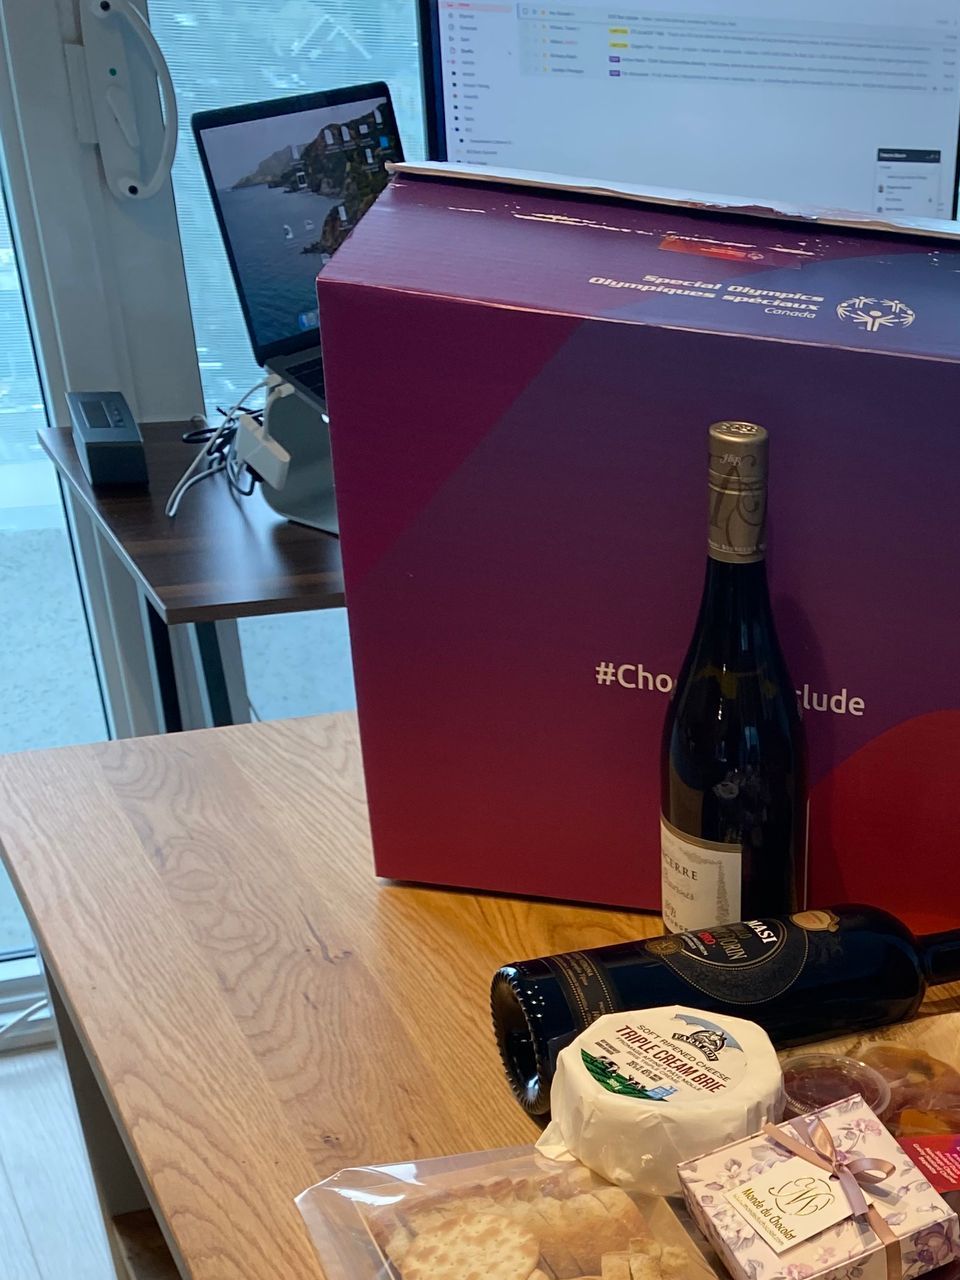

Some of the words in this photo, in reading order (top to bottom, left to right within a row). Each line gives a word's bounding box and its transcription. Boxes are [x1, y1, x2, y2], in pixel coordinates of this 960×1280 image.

[588, 276, 716, 298] Olympiques
[642, 274, 722, 290] Special
[727, 285, 825, 303] Olympics
[764, 306, 817, 320] Canada
[616, 1025, 660, 1053] TRIPLE
[653, 1050, 699, 1076] CREAM
[692, 1069, 727, 1093] BRIE
[637, 1025, 661, 1039] SOFT
[660, 1039, 696, 1061] RIPENED
[696, 1060, 731, 1082] CHEESE
[742, 1188, 765, 1209] Monde
[760, 1206, 773, 1217] du
[769, 1215, 796, 1240] Chocolat
